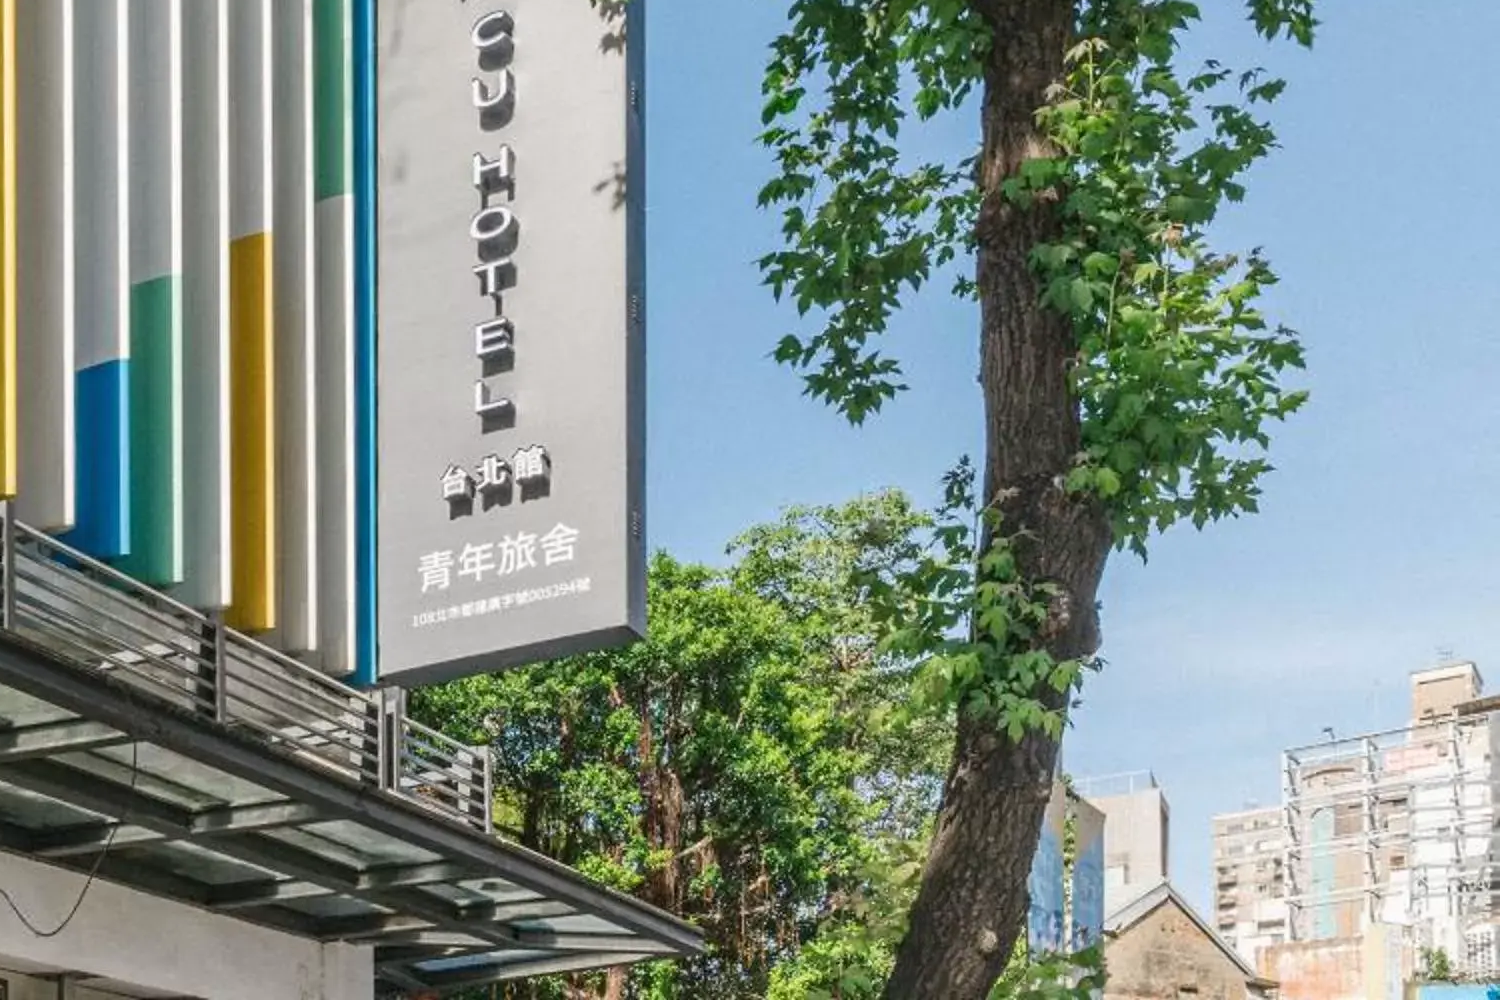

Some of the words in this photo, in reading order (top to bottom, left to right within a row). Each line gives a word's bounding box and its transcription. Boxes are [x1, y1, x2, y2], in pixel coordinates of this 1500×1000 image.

[471, 10, 507, 107] CU
[470, 145, 511, 412] HOTEL
[441, 445, 545, 498] 台北館
[417, 522, 580, 593] 青年旅舍
